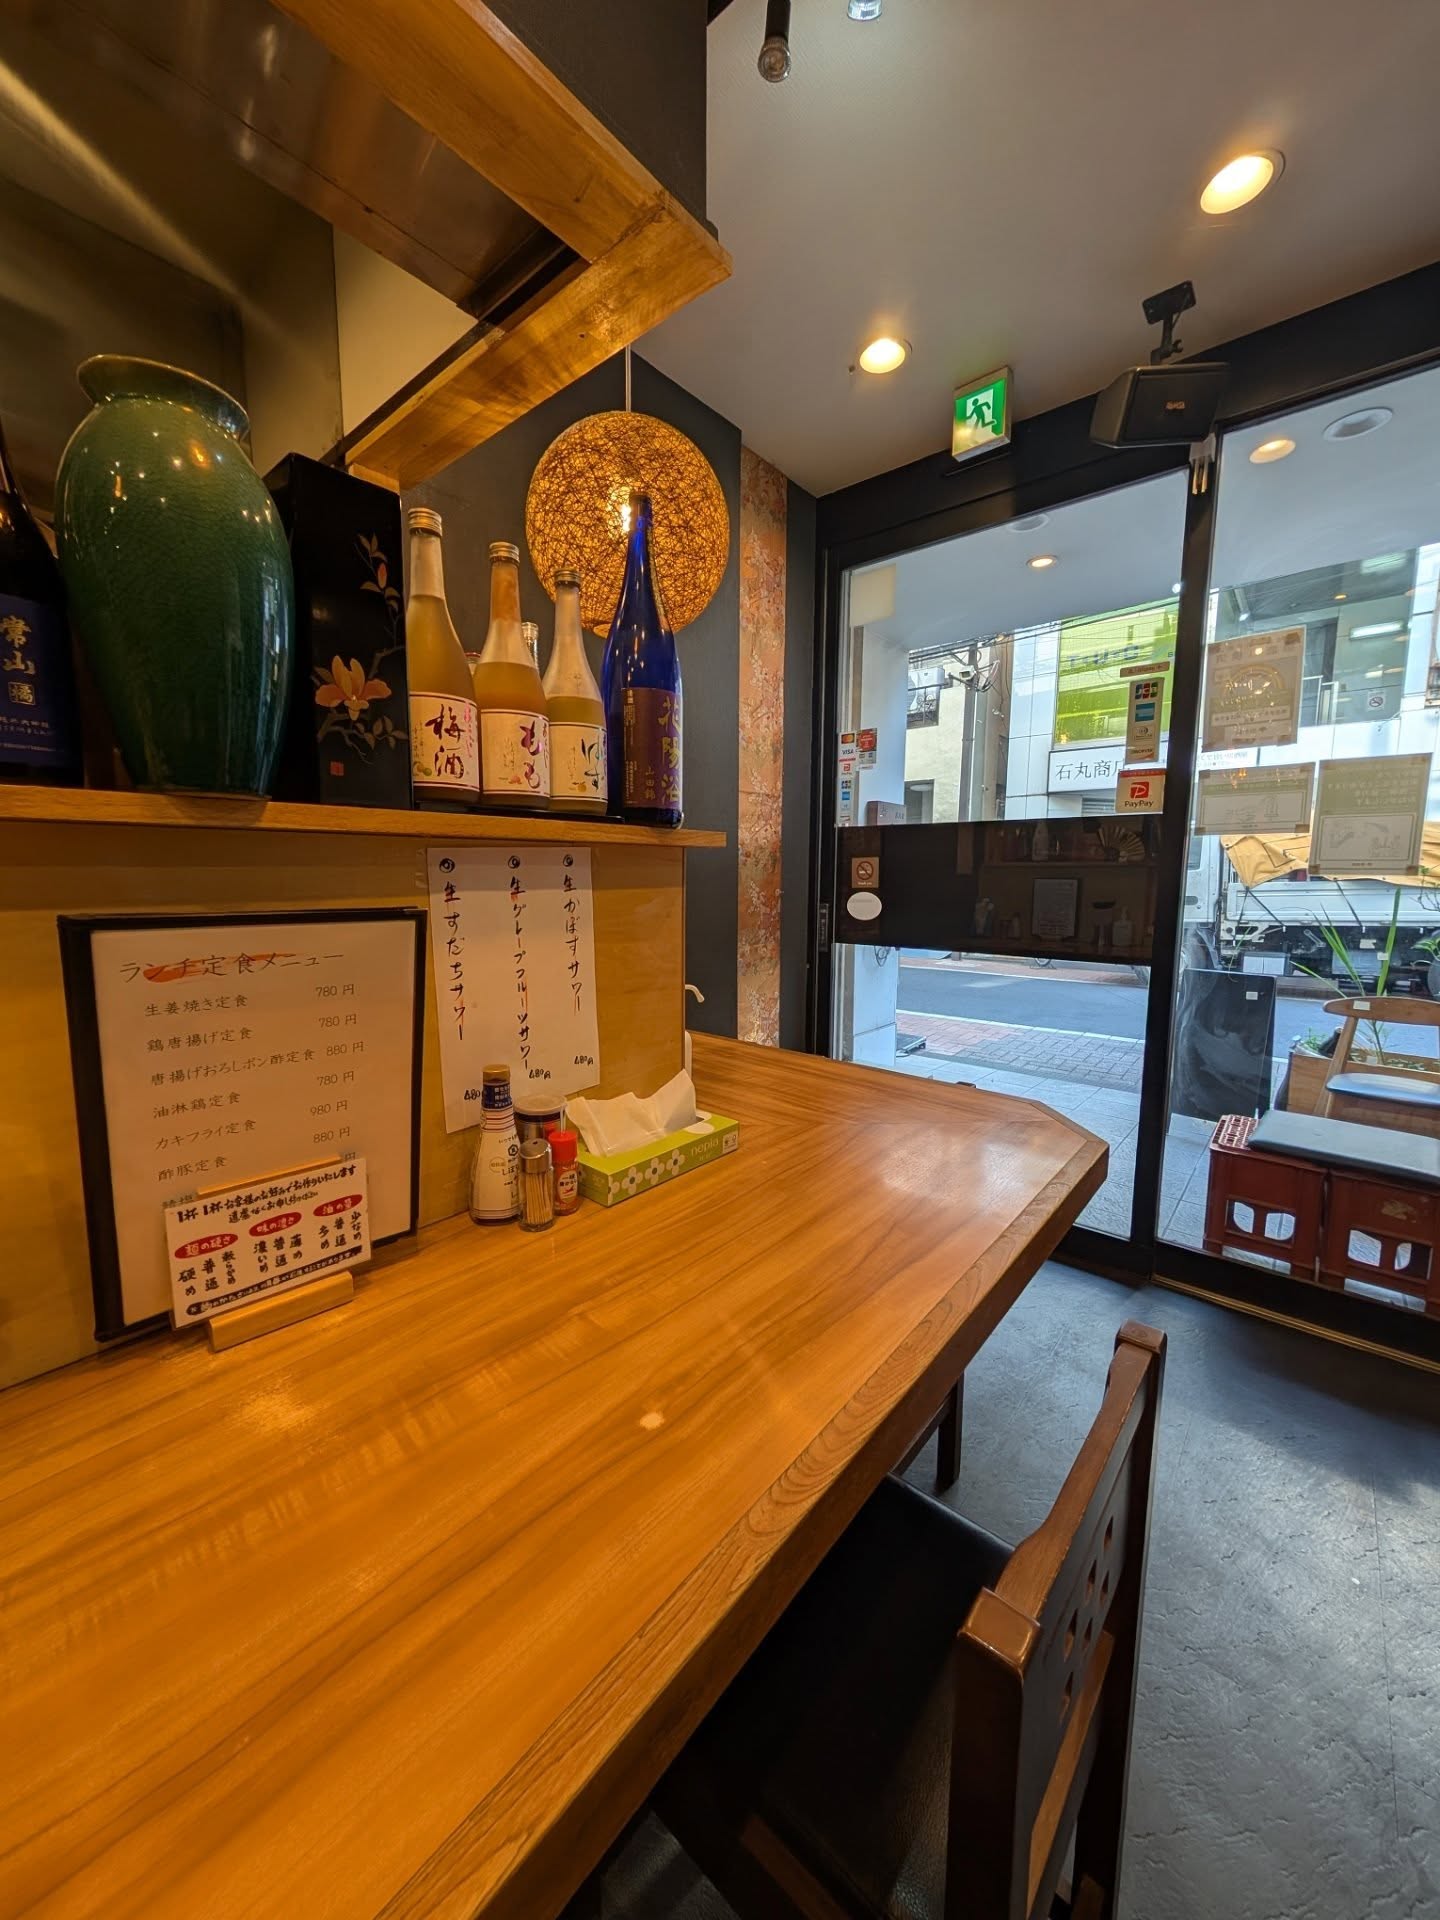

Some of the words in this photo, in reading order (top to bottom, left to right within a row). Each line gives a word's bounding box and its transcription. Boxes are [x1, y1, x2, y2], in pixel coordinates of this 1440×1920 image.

[0, 615, 36, 675] 常山
[425, 703, 465, 779] 梅酒
[519, 720, 542, 789] もも
[581, 735, 601, 791] ゆず
[1125, 800, 1154, 808] PayPay
[563, 874, 582, 1012] 生かぼすサワー
[119, 951, 344, 984] ランチ定食メニュー
[444, 881, 466, 1040] 生すだちサワー
[509, 876, 531, 1070] 生グレープフルーツサワー
[145, 994, 249, 1016] 生姜焼き定食
[147, 1027, 253, 1052] 鶏唐揚げ定食
[153, 1091, 241, 1119] 油淋鶏定食
[155, 1119, 257, 1151] カキフライ定食
[158, 1156, 227, 1181] 酢豚定食
[318, 1225, 330, 1250] 多め
[333, 1217, 347, 1247] 普通
[351, 1211, 362, 1240] 少なめ
[184, 1235, 232, 1256] 麺の硬さ
[253, 1240, 269, 1273] 濃いめ
[272, 1237, 288, 1268] 普通
[177, 1267, 197, 1296] 硬め
[201, 1259, 220, 1291] 普通
